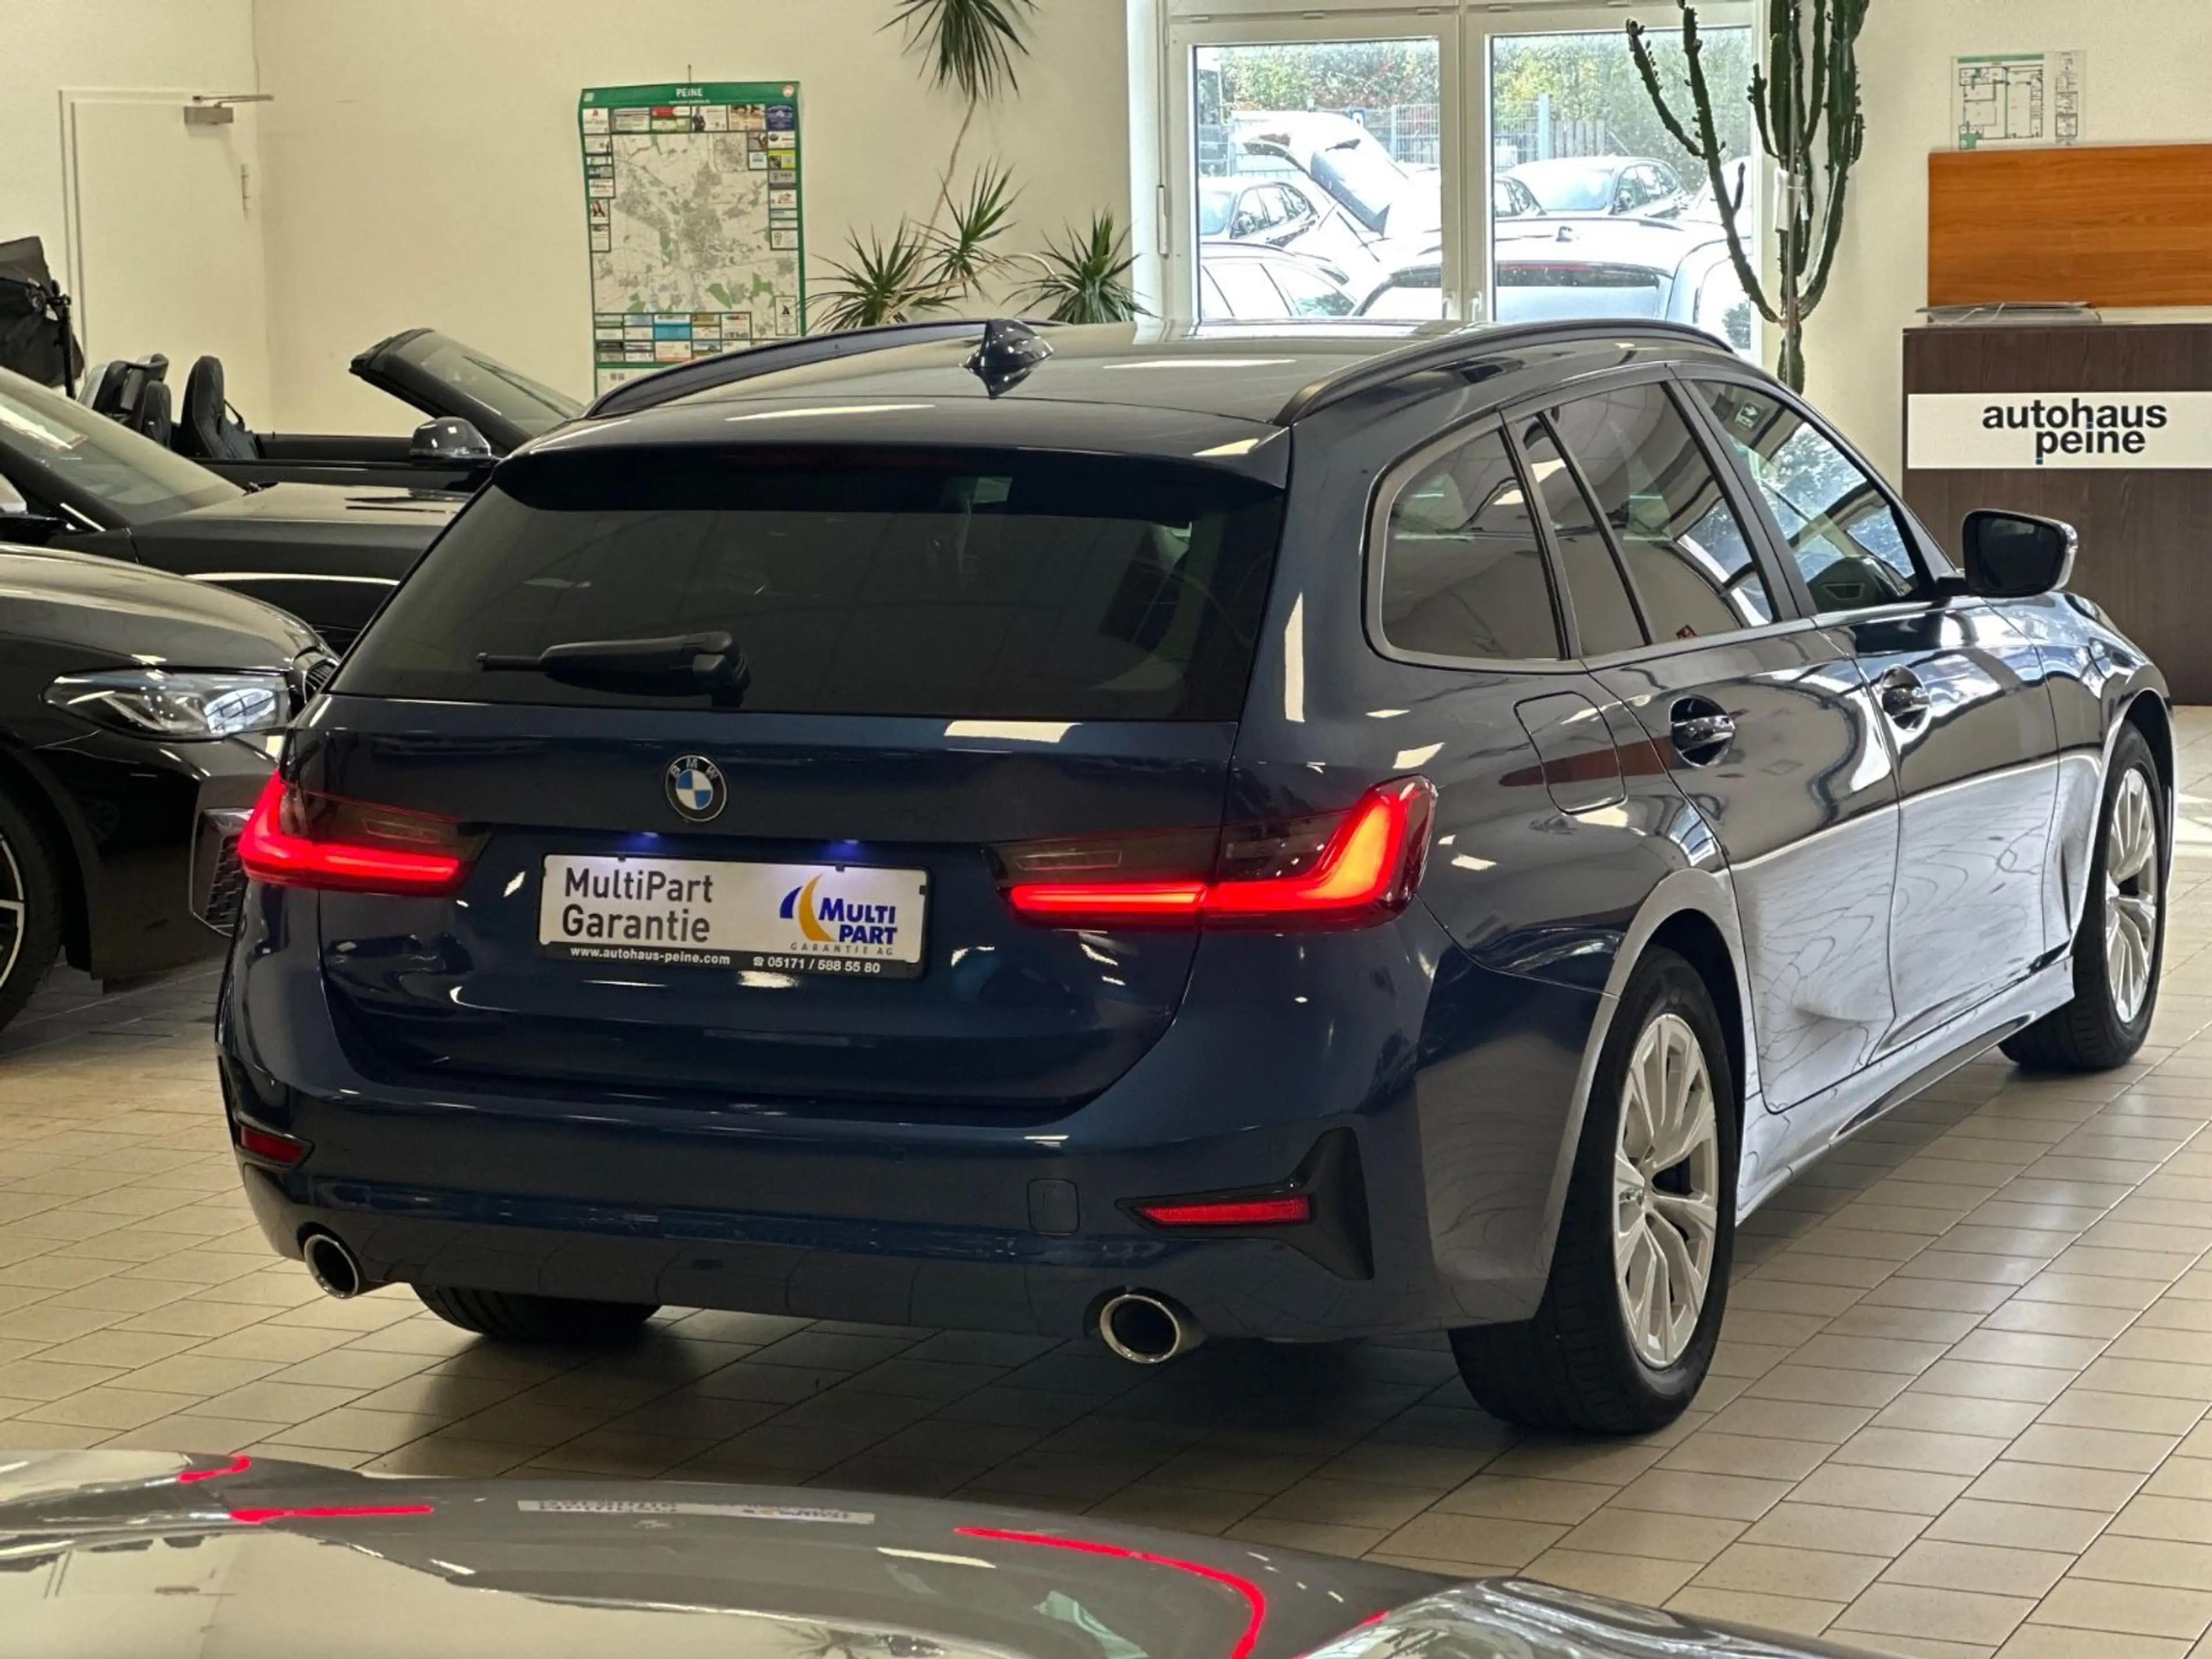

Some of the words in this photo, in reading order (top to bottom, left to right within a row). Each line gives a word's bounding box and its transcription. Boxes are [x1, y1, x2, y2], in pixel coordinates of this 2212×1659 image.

[676, 88, 703, 97] PEINE
[1982, 398, 2167, 429] autohaus
[2035, 430, 2146, 465] peine
[670, 757, 719, 779] BMW
[565, 868, 713, 903] MultiPart
[819, 897, 896, 924] MULTI
[562, 903, 710, 942] Garantie
[839, 925, 897, 944] PART
[570, 947, 730, 965] www.autohaus-peine.com
[790, 942, 868, 954] GARANTIE
[877, 948, 893, 956] AG
[767, 957, 805, 969] 05171
[809, 959, 815, 969] /
[817, 960, 842, 971] 588
[844, 961, 861, 971] 55
[864, 963, 881, 973] 80
